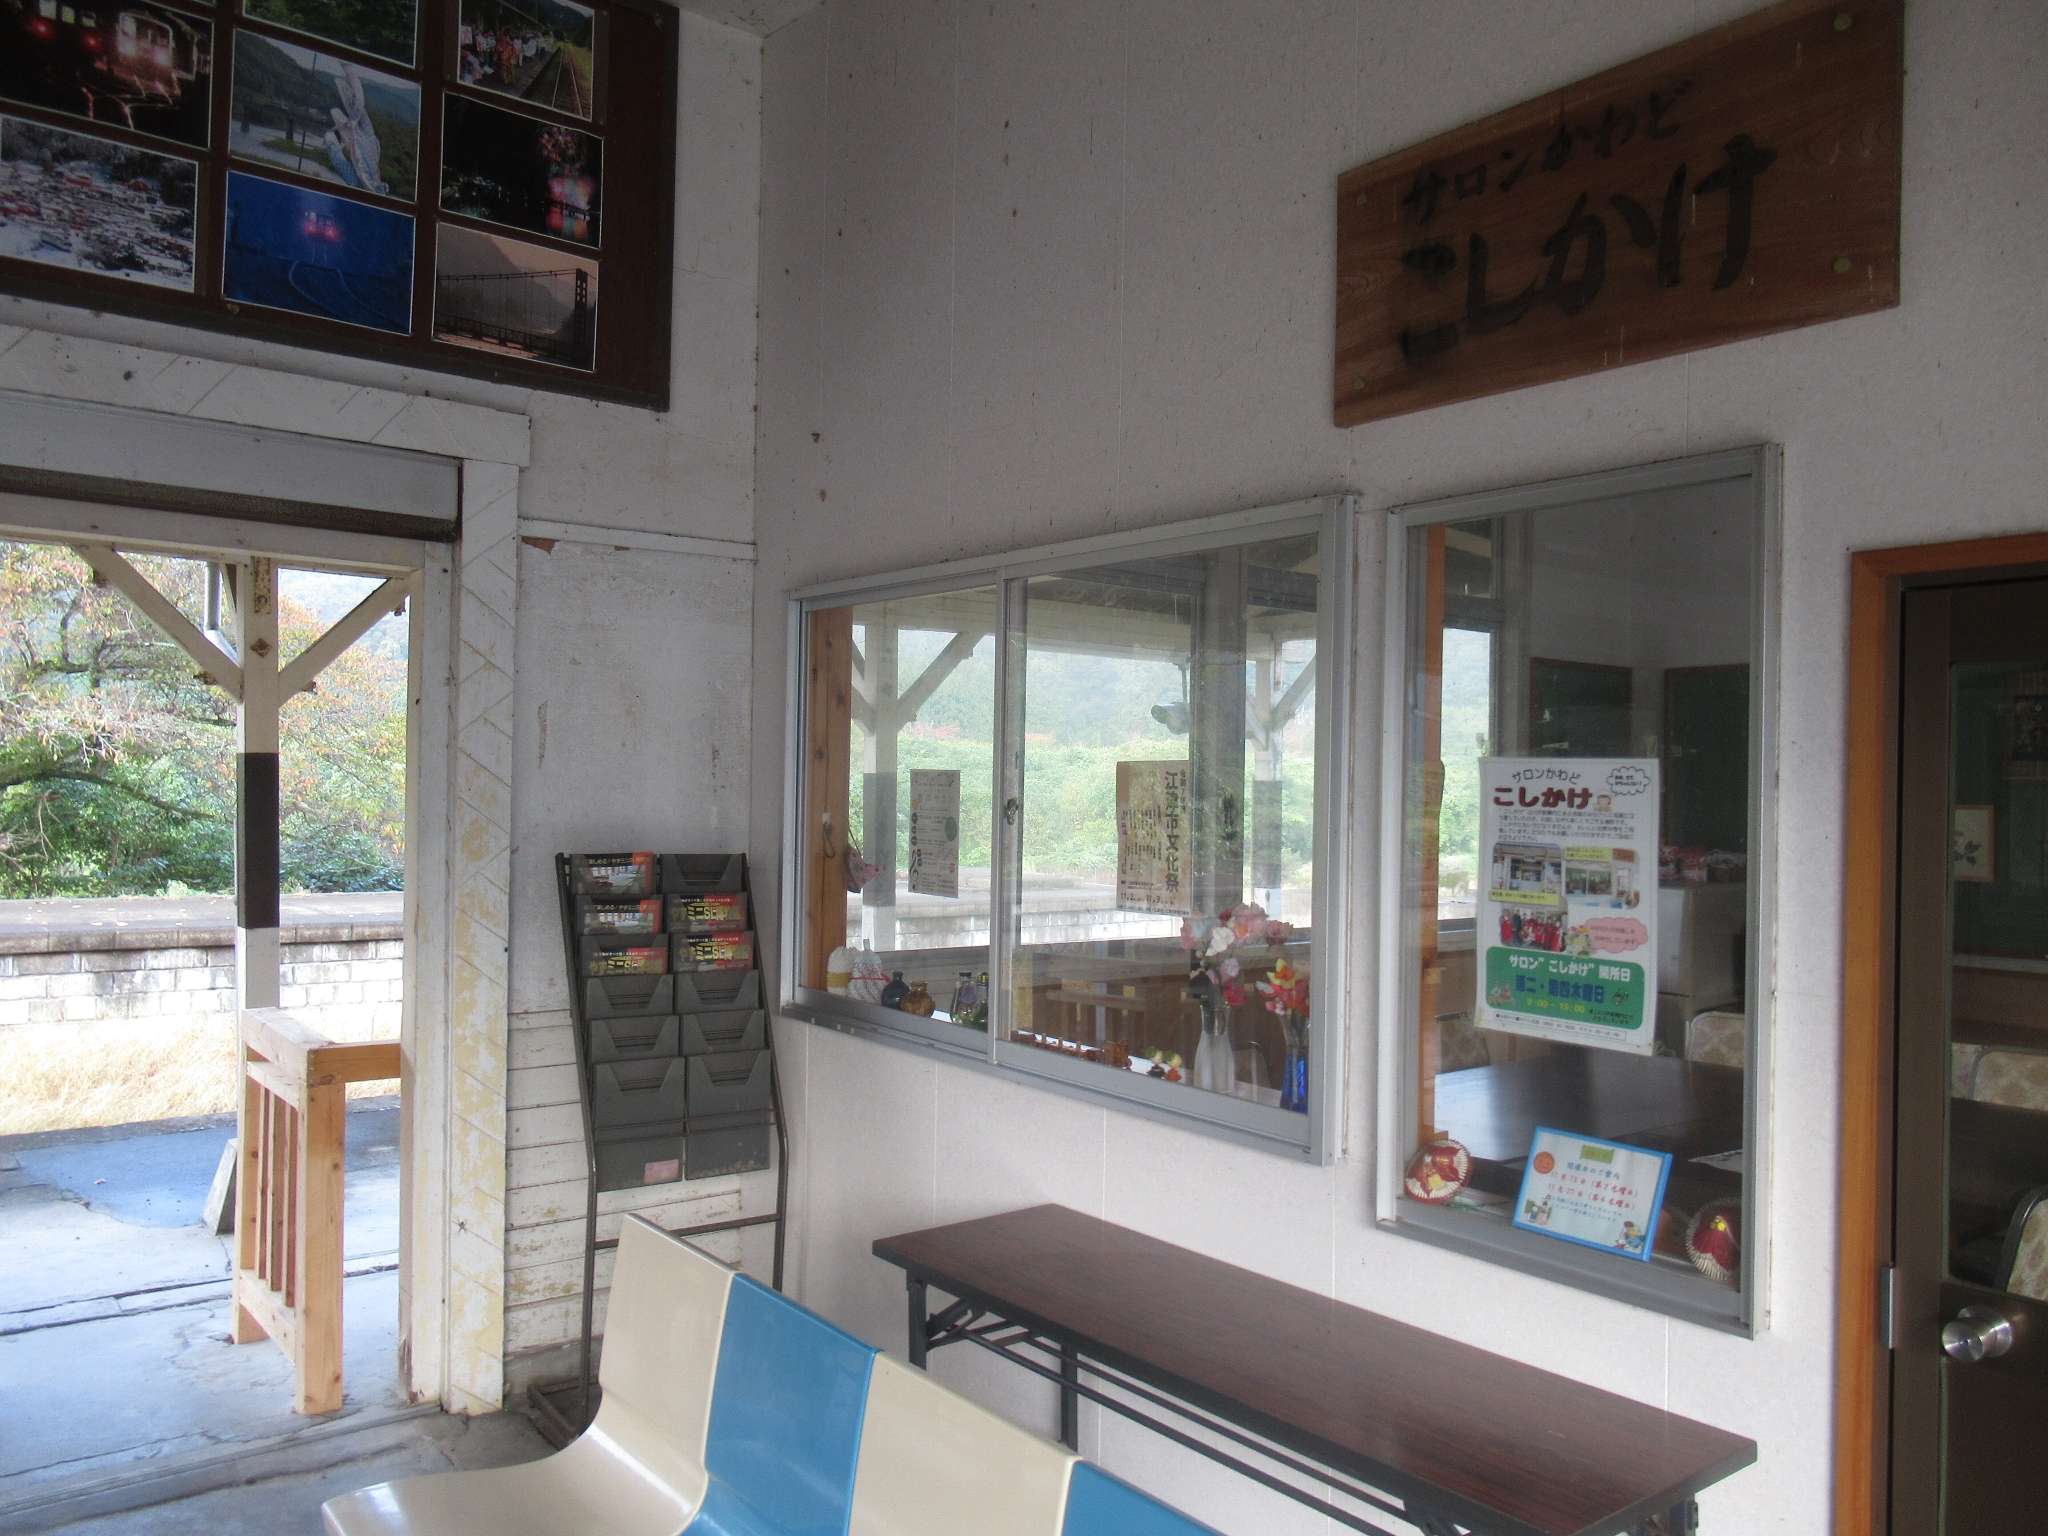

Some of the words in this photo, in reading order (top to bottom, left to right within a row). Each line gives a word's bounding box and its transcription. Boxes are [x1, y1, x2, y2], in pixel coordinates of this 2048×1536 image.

[1404, 76, 1696, 225] サロンかわど
[1397, 133, 1777, 362] こしかけ
[1493, 786, 1593, 809] こしかけ
[1512, 768, 1581, 784] サロンかわど
